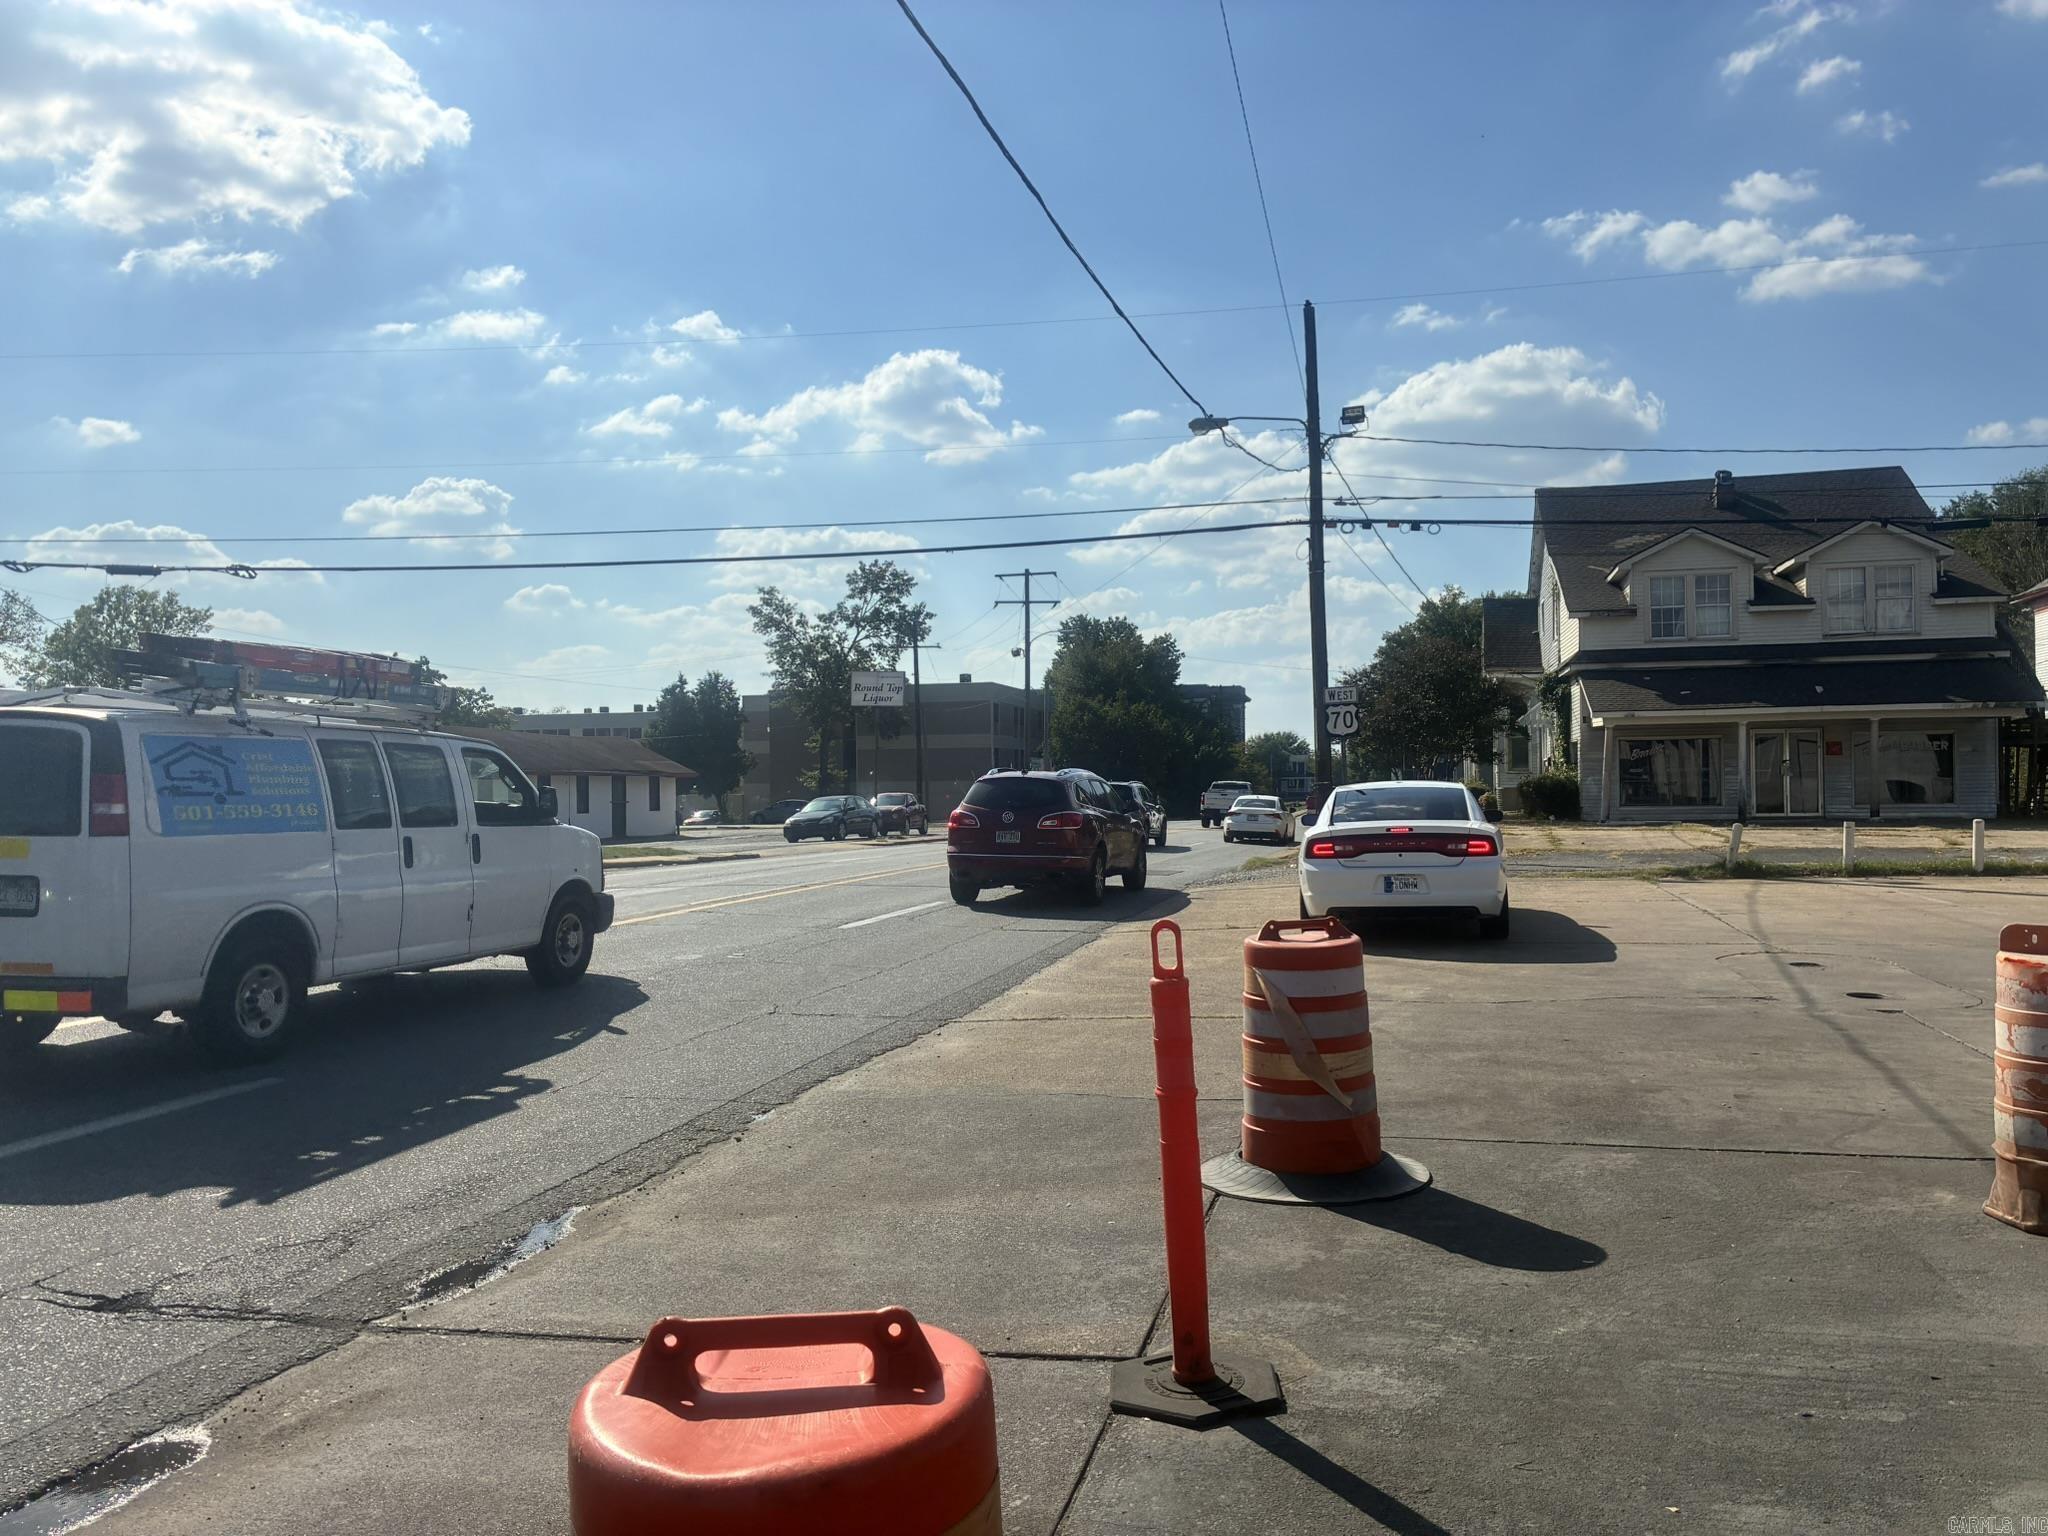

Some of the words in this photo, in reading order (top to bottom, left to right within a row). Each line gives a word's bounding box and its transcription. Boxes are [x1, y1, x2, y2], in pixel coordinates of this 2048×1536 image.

[854, 682, 884, 691] Round
[887, 682, 903, 694] Top
[863, 693, 894, 704] Liquor
[1327, 690, 1354, 700] WEST
[1330, 711, 1354, 729] 70
[246, 763, 313, 772] Affordable
[249, 775, 311, 785] Plumbing
[252, 786, 311, 795] Solutions
